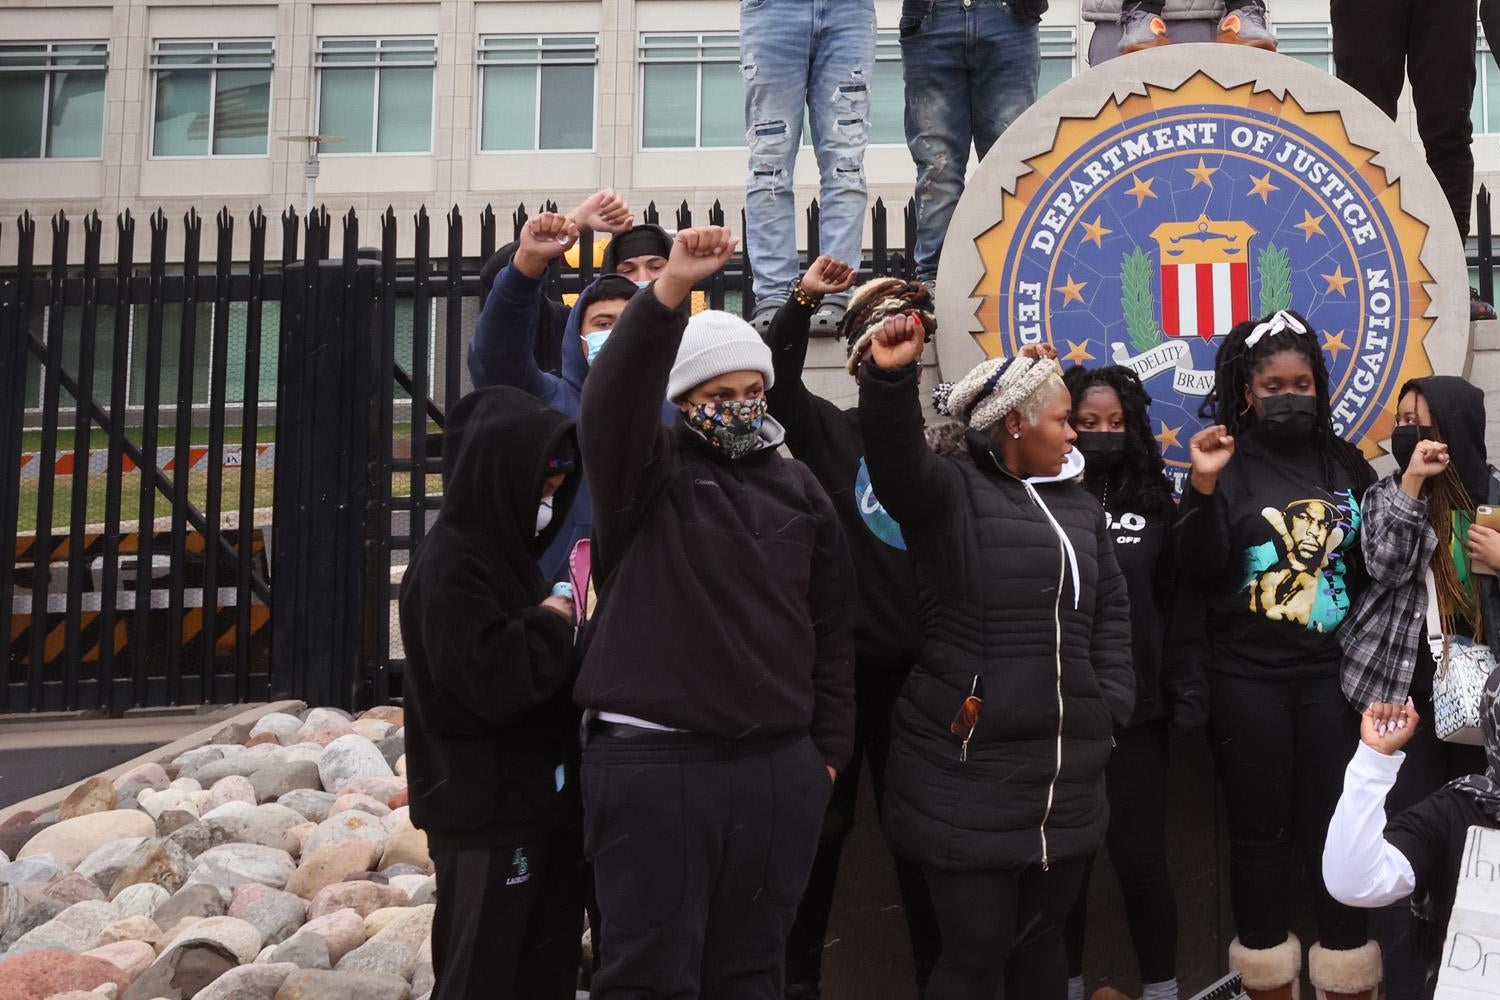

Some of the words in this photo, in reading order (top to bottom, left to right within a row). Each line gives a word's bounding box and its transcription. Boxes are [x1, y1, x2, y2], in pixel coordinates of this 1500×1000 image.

[1031, 123, 1217, 256] DEPARTMENT
[1231, 126, 1274, 154] OF
[1275, 141, 1378, 246] JUSTICE
[1129, 346, 1183, 375] IDELITY
[1330, 267, 1391, 437] TIGATION
[1177, 371, 1214, 390] BRAV
[1116, 535, 1141, 544] OFF
